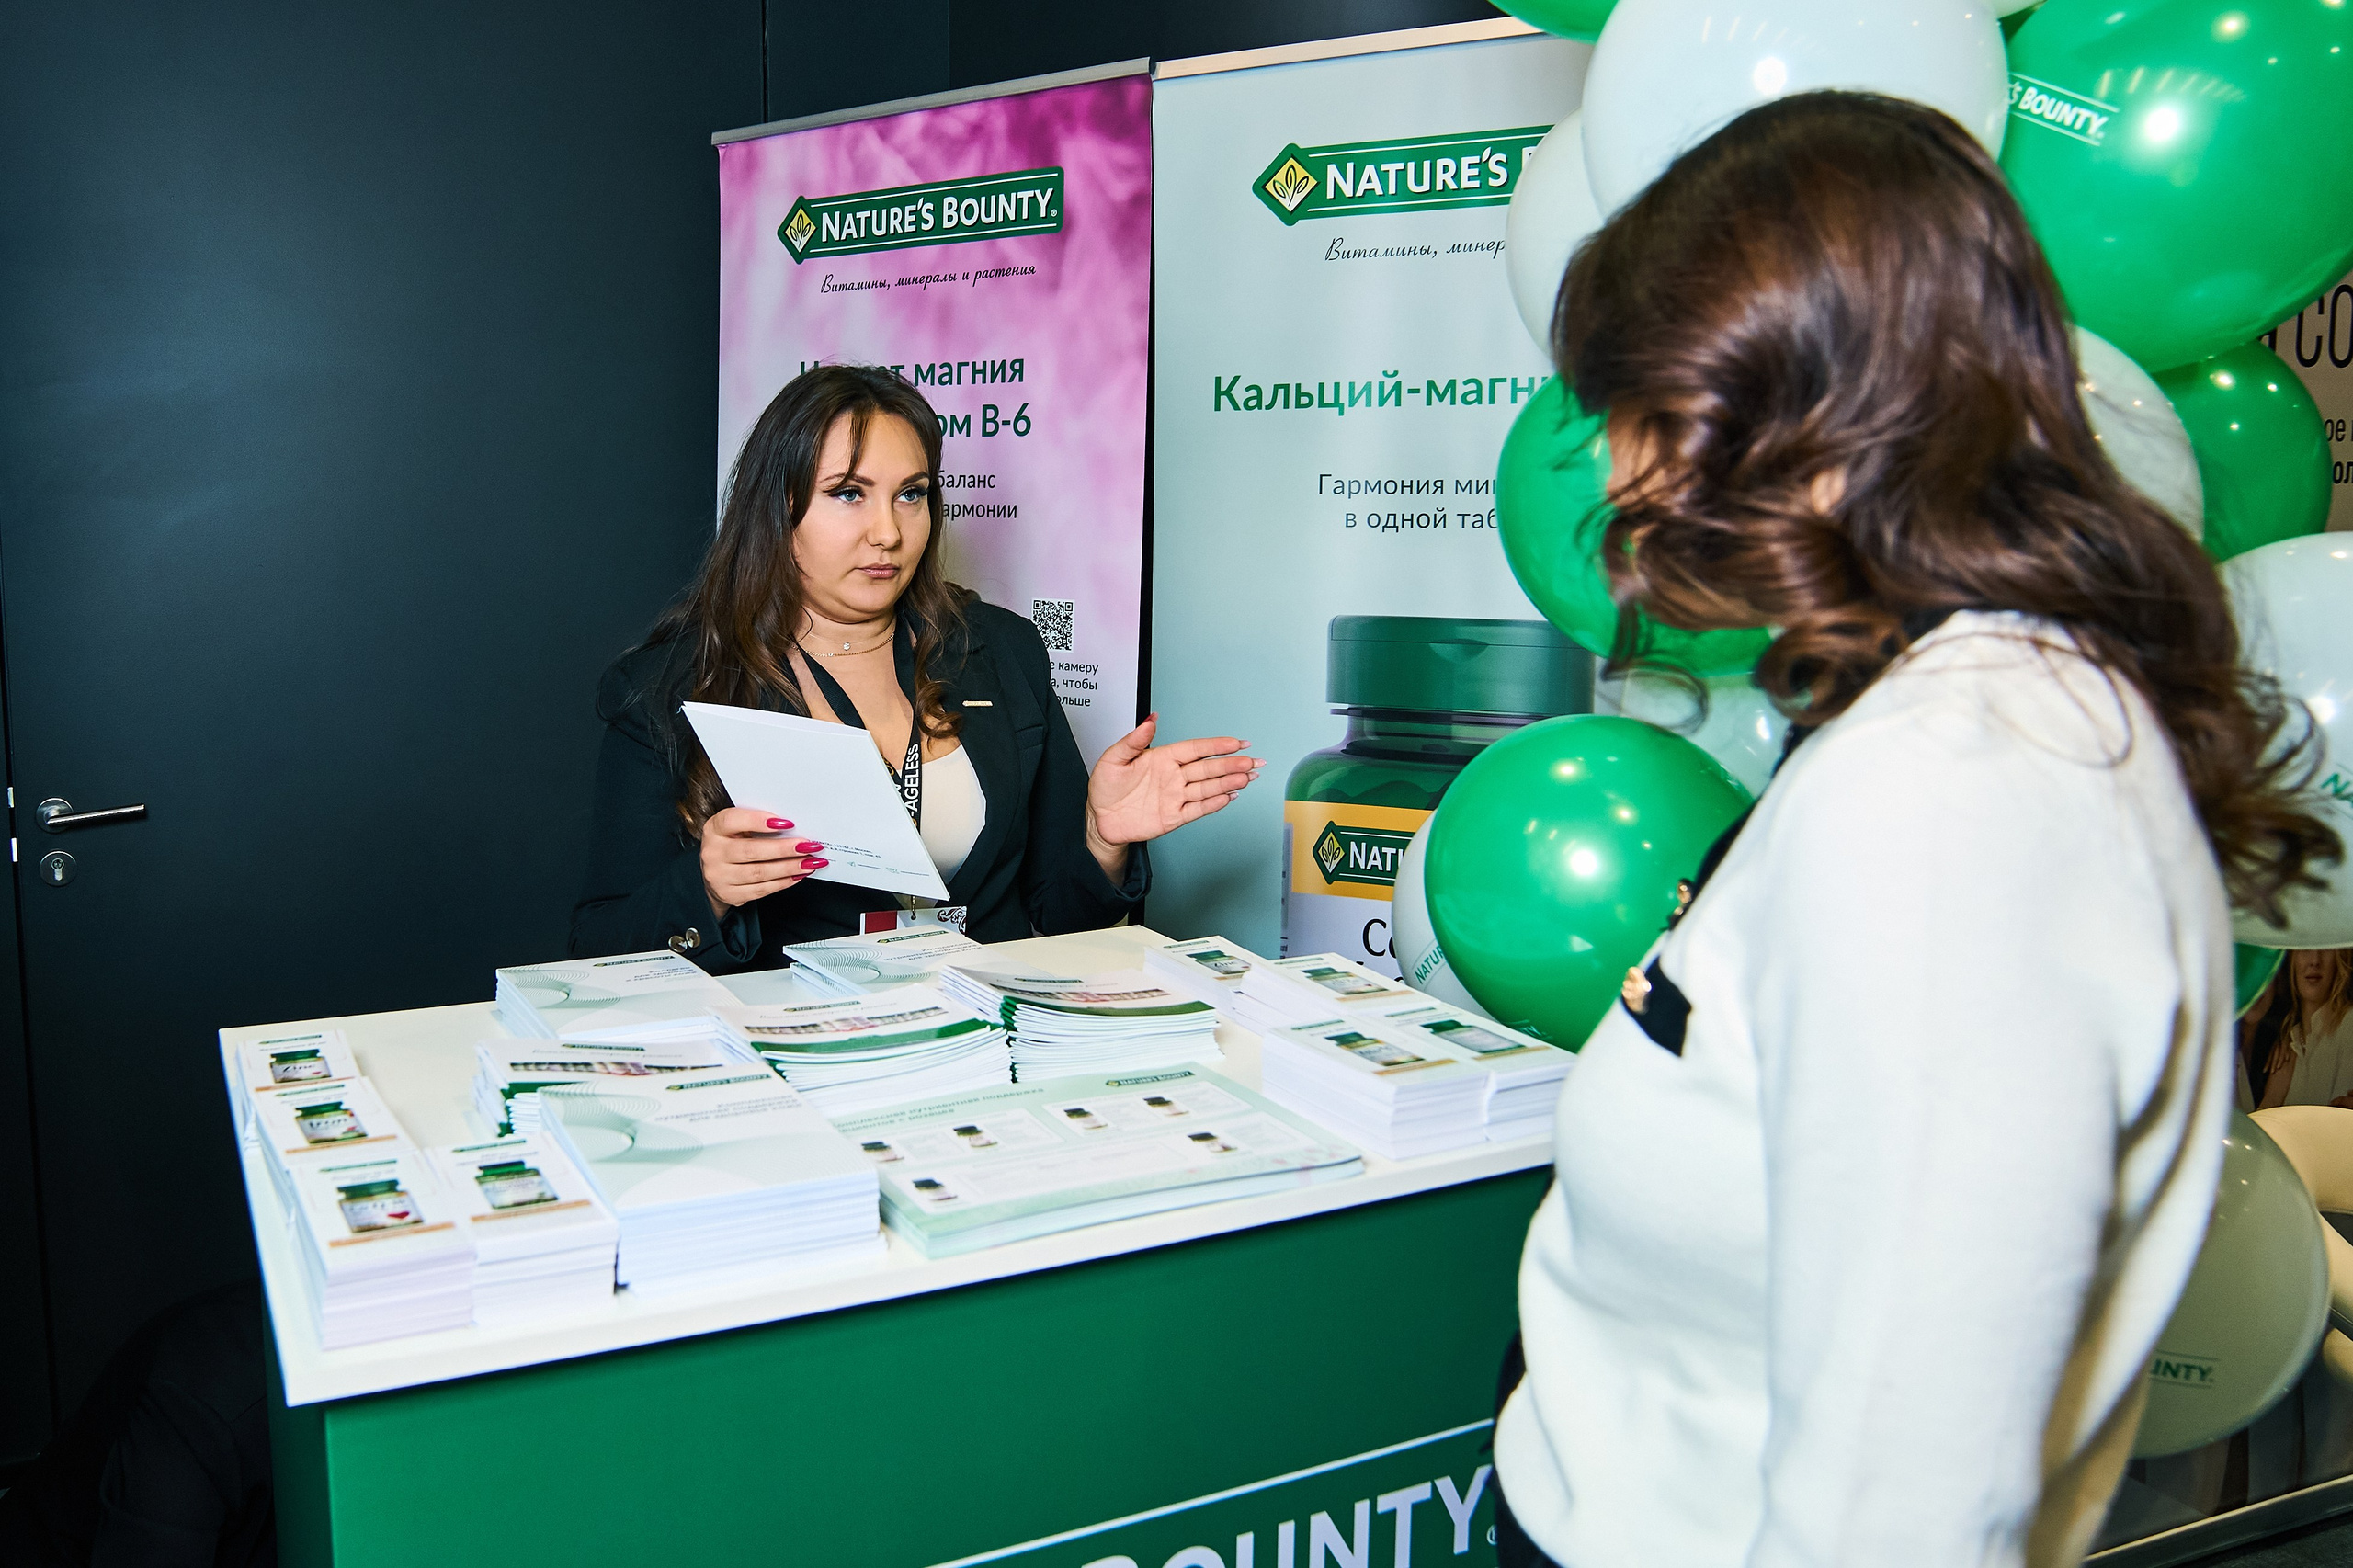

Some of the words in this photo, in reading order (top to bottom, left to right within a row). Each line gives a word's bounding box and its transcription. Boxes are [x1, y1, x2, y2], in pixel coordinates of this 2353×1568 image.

[2018, 86, 2109, 135] BOUNTY
[1325, 146, 1508, 199] NATURE'S
[821, 197, 935, 242] NATURE'S
[942, 187, 1054, 230] BOUNTY
[1324, 237, 1438, 262] Витамины,
[820, 273, 892, 293] Витамины,
[894, 272, 957, 290] минералы
[962, 271, 970, 281] и
[972, 265, 1037, 287] растения
[915, 358, 1025, 386] магния
[1213, 370, 1548, 416] Кальций-магн
[1317, 474, 1444, 500] Гармония
[943, 503, 1017, 522] армонии
[1345, 512, 1357, 528] в
[1367, 507, 1448, 532] одной
[1058, 662, 1099, 676] камеру
[1062, 678, 1097, 690] чтобы
[1057, 695, 1091, 707] ольше
[1415, 946, 1444, 984] NATUR
